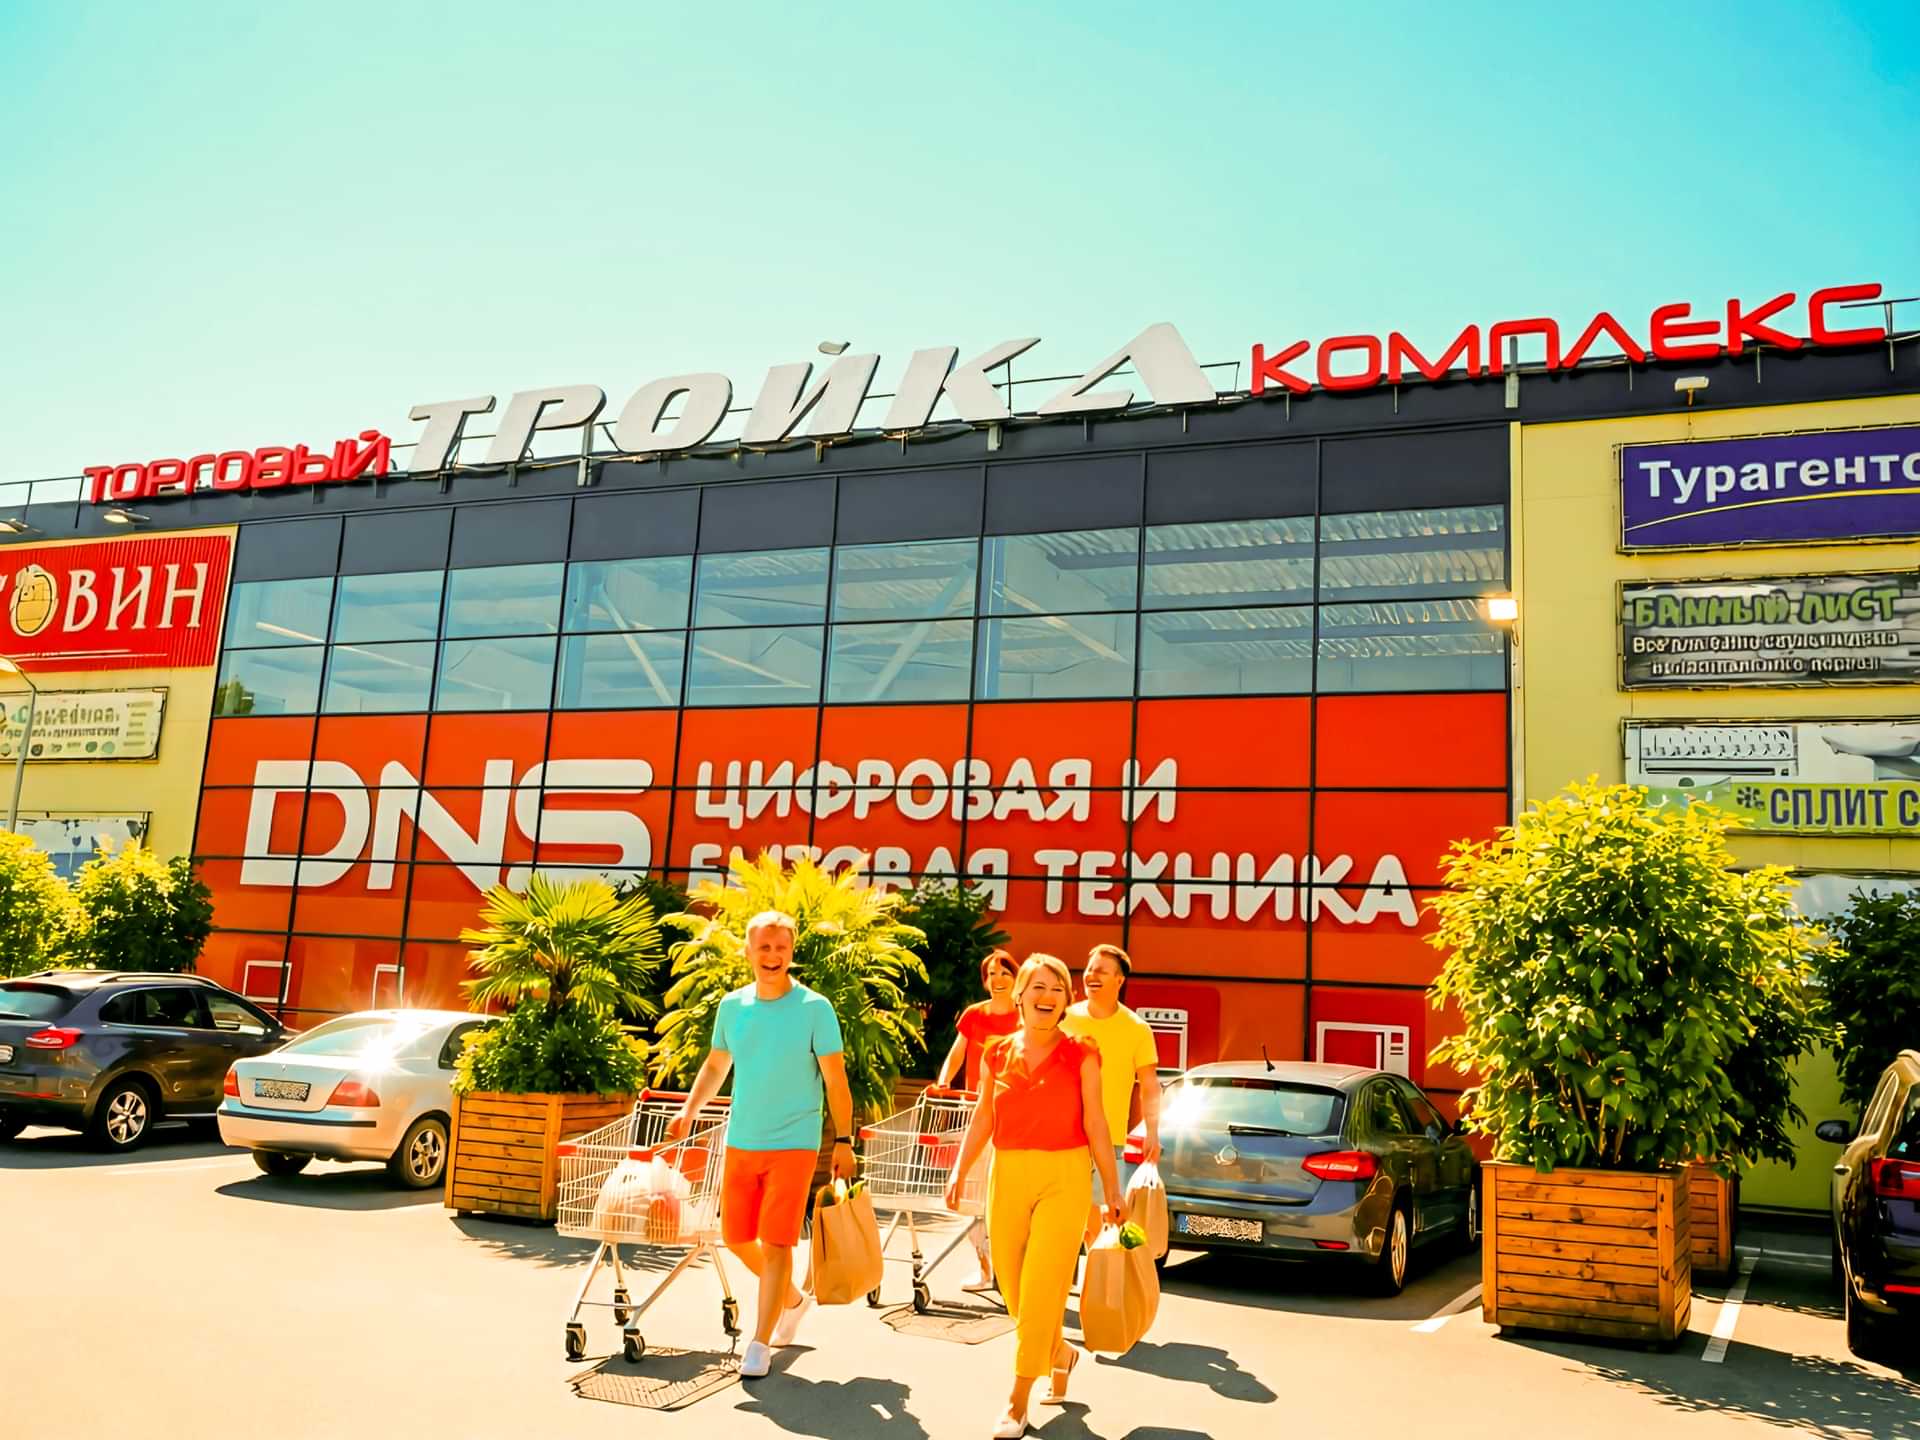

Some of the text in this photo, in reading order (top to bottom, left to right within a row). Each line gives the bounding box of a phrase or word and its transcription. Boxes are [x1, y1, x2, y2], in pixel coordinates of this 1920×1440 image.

[84, 283, 1886, 504] ТОРГОВЫЙ ТРОЙКА КОМПЛЕКС
[239, 758, 654, 890] DNS
[694, 756, 1178, 829] ЦИФРОВАЯ И
[1770, 788, 1889, 827] СПЛИТ
[1032, 848, 1420, 927] ТЕХНИКА
